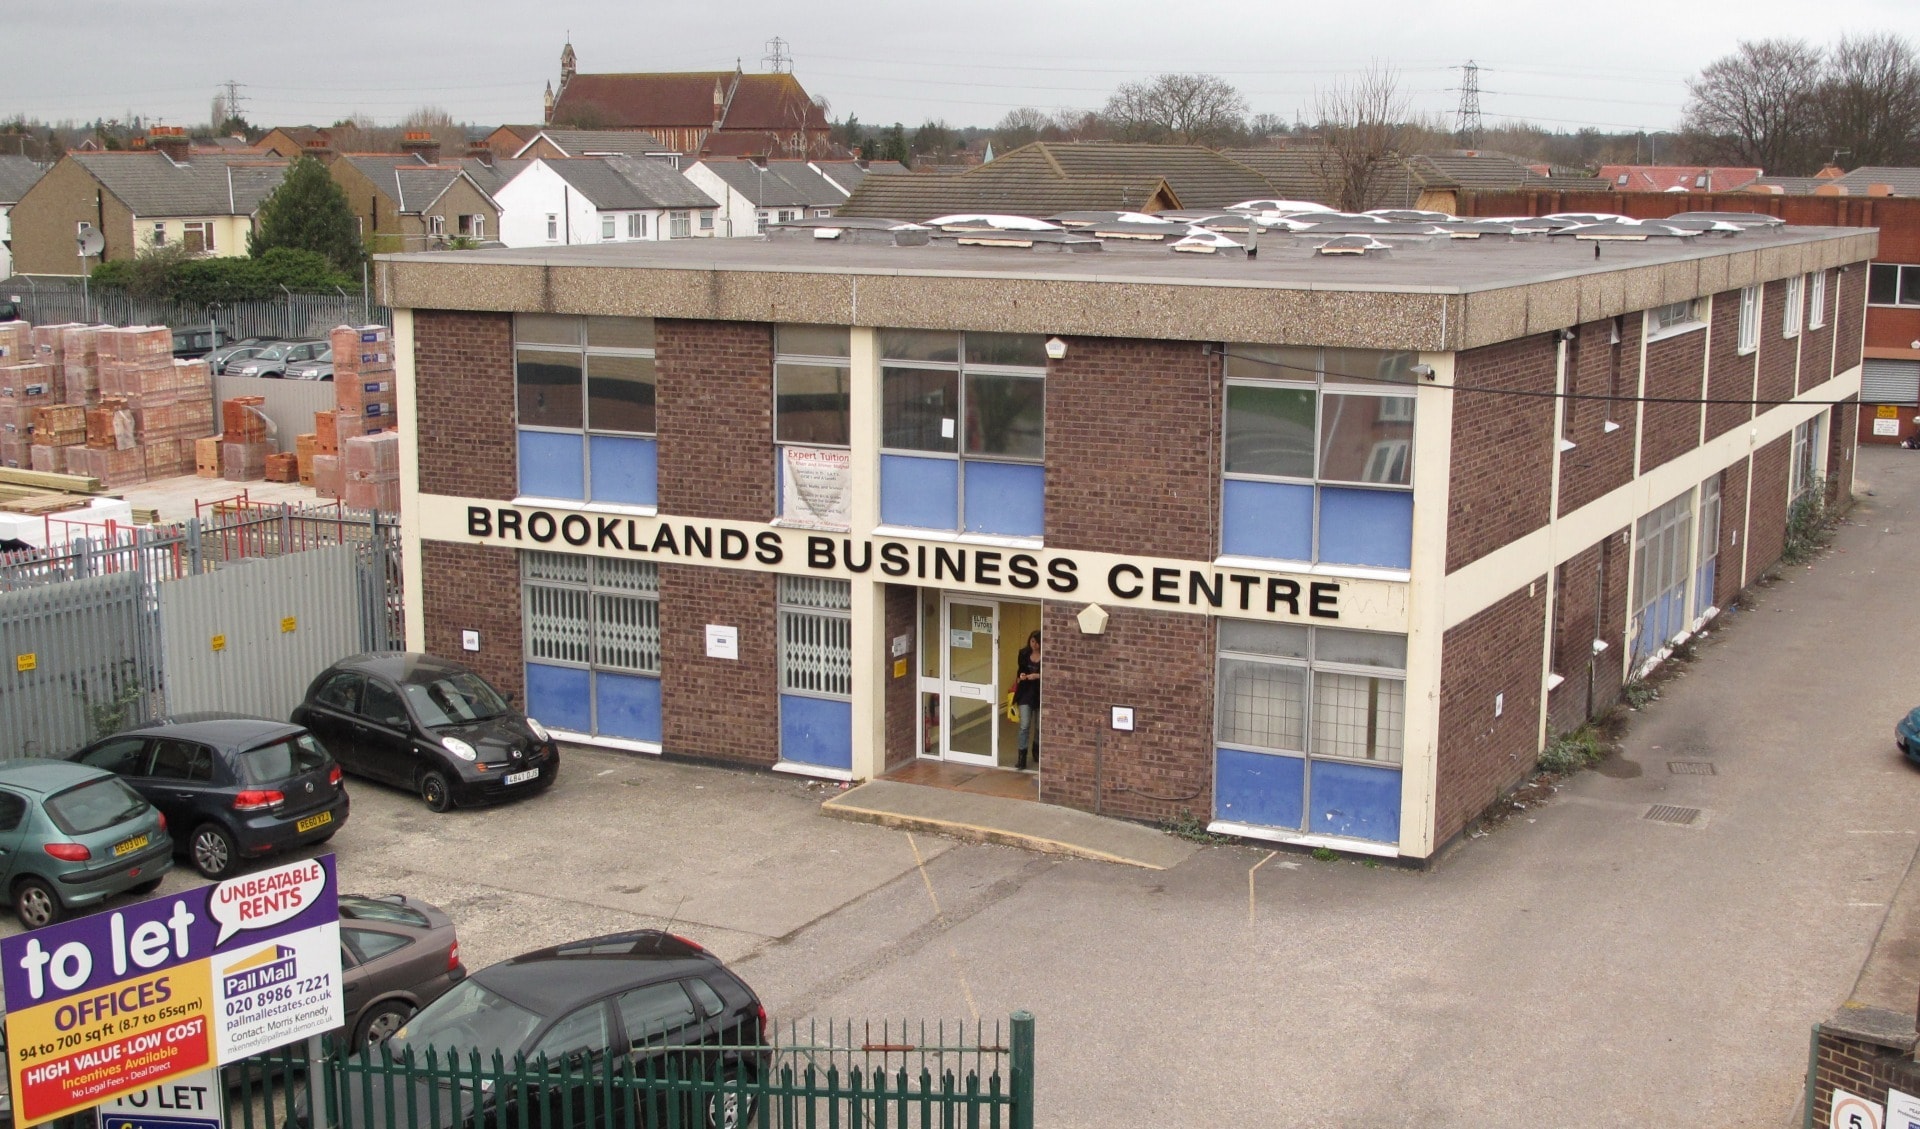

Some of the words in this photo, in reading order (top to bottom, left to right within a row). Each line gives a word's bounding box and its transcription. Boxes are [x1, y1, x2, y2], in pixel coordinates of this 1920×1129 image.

[788, 450, 816, 460] Expert
[820, 452, 849, 462] Tuition
[467, 506, 783, 565] BROOKLANDS
[807, 536, 1079, 593] BUSINESS
[1107, 563, 1340, 619] CENTRE
[300, 816, 317, 830] RE60
[114, 841, 133, 854] RE03
[220, 864, 319, 904] UNBEATABLE
[239, 886, 302, 921] RENTS
[20, 938, 93, 999] to
[110, 900, 196, 976] let
[226, 996, 253, 1016] 020
[257, 984, 292, 1007] 8986
[296, 973, 330, 995] 7221
[227, 972, 257, 996] Pall
[259, 965, 294, 986] Mall
[54, 976, 171, 1031] OFFICES
[227, 989, 332, 1031] pallmallestates.co.uk
[20, 1046, 37, 1061] 94
[39, 1043, 54, 1055] to
[56, 1033, 81, 1051] 700
[119, 1016, 140, 1033] (8.7
[143, 1012, 156, 1025] to
[227, 1015, 333, 1054] mkennedy@pallmall.demon.co.uk
[231, 1026, 265, 1042] Contact:
[267, 1016, 293, 1032] Morris
[295, 1005, 329, 1023] Kennedy
[28, 1060, 70, 1086] HIGH
[165, 1019, 203, 1043] COST
[62, 1062, 121, 1090] Incentives
[125, 1045, 178, 1071] Available
[72, 1089, 84, 1099] No
[85, 1081, 106, 1095] Legal
[107, 1076, 125, 1087] Fees
[130, 1069, 148, 1080] Deal
[149, 1061, 171, 1074] Direct
[157, 1085, 207, 1110] LET
[1849, 1113, 1862, 1129] 5
